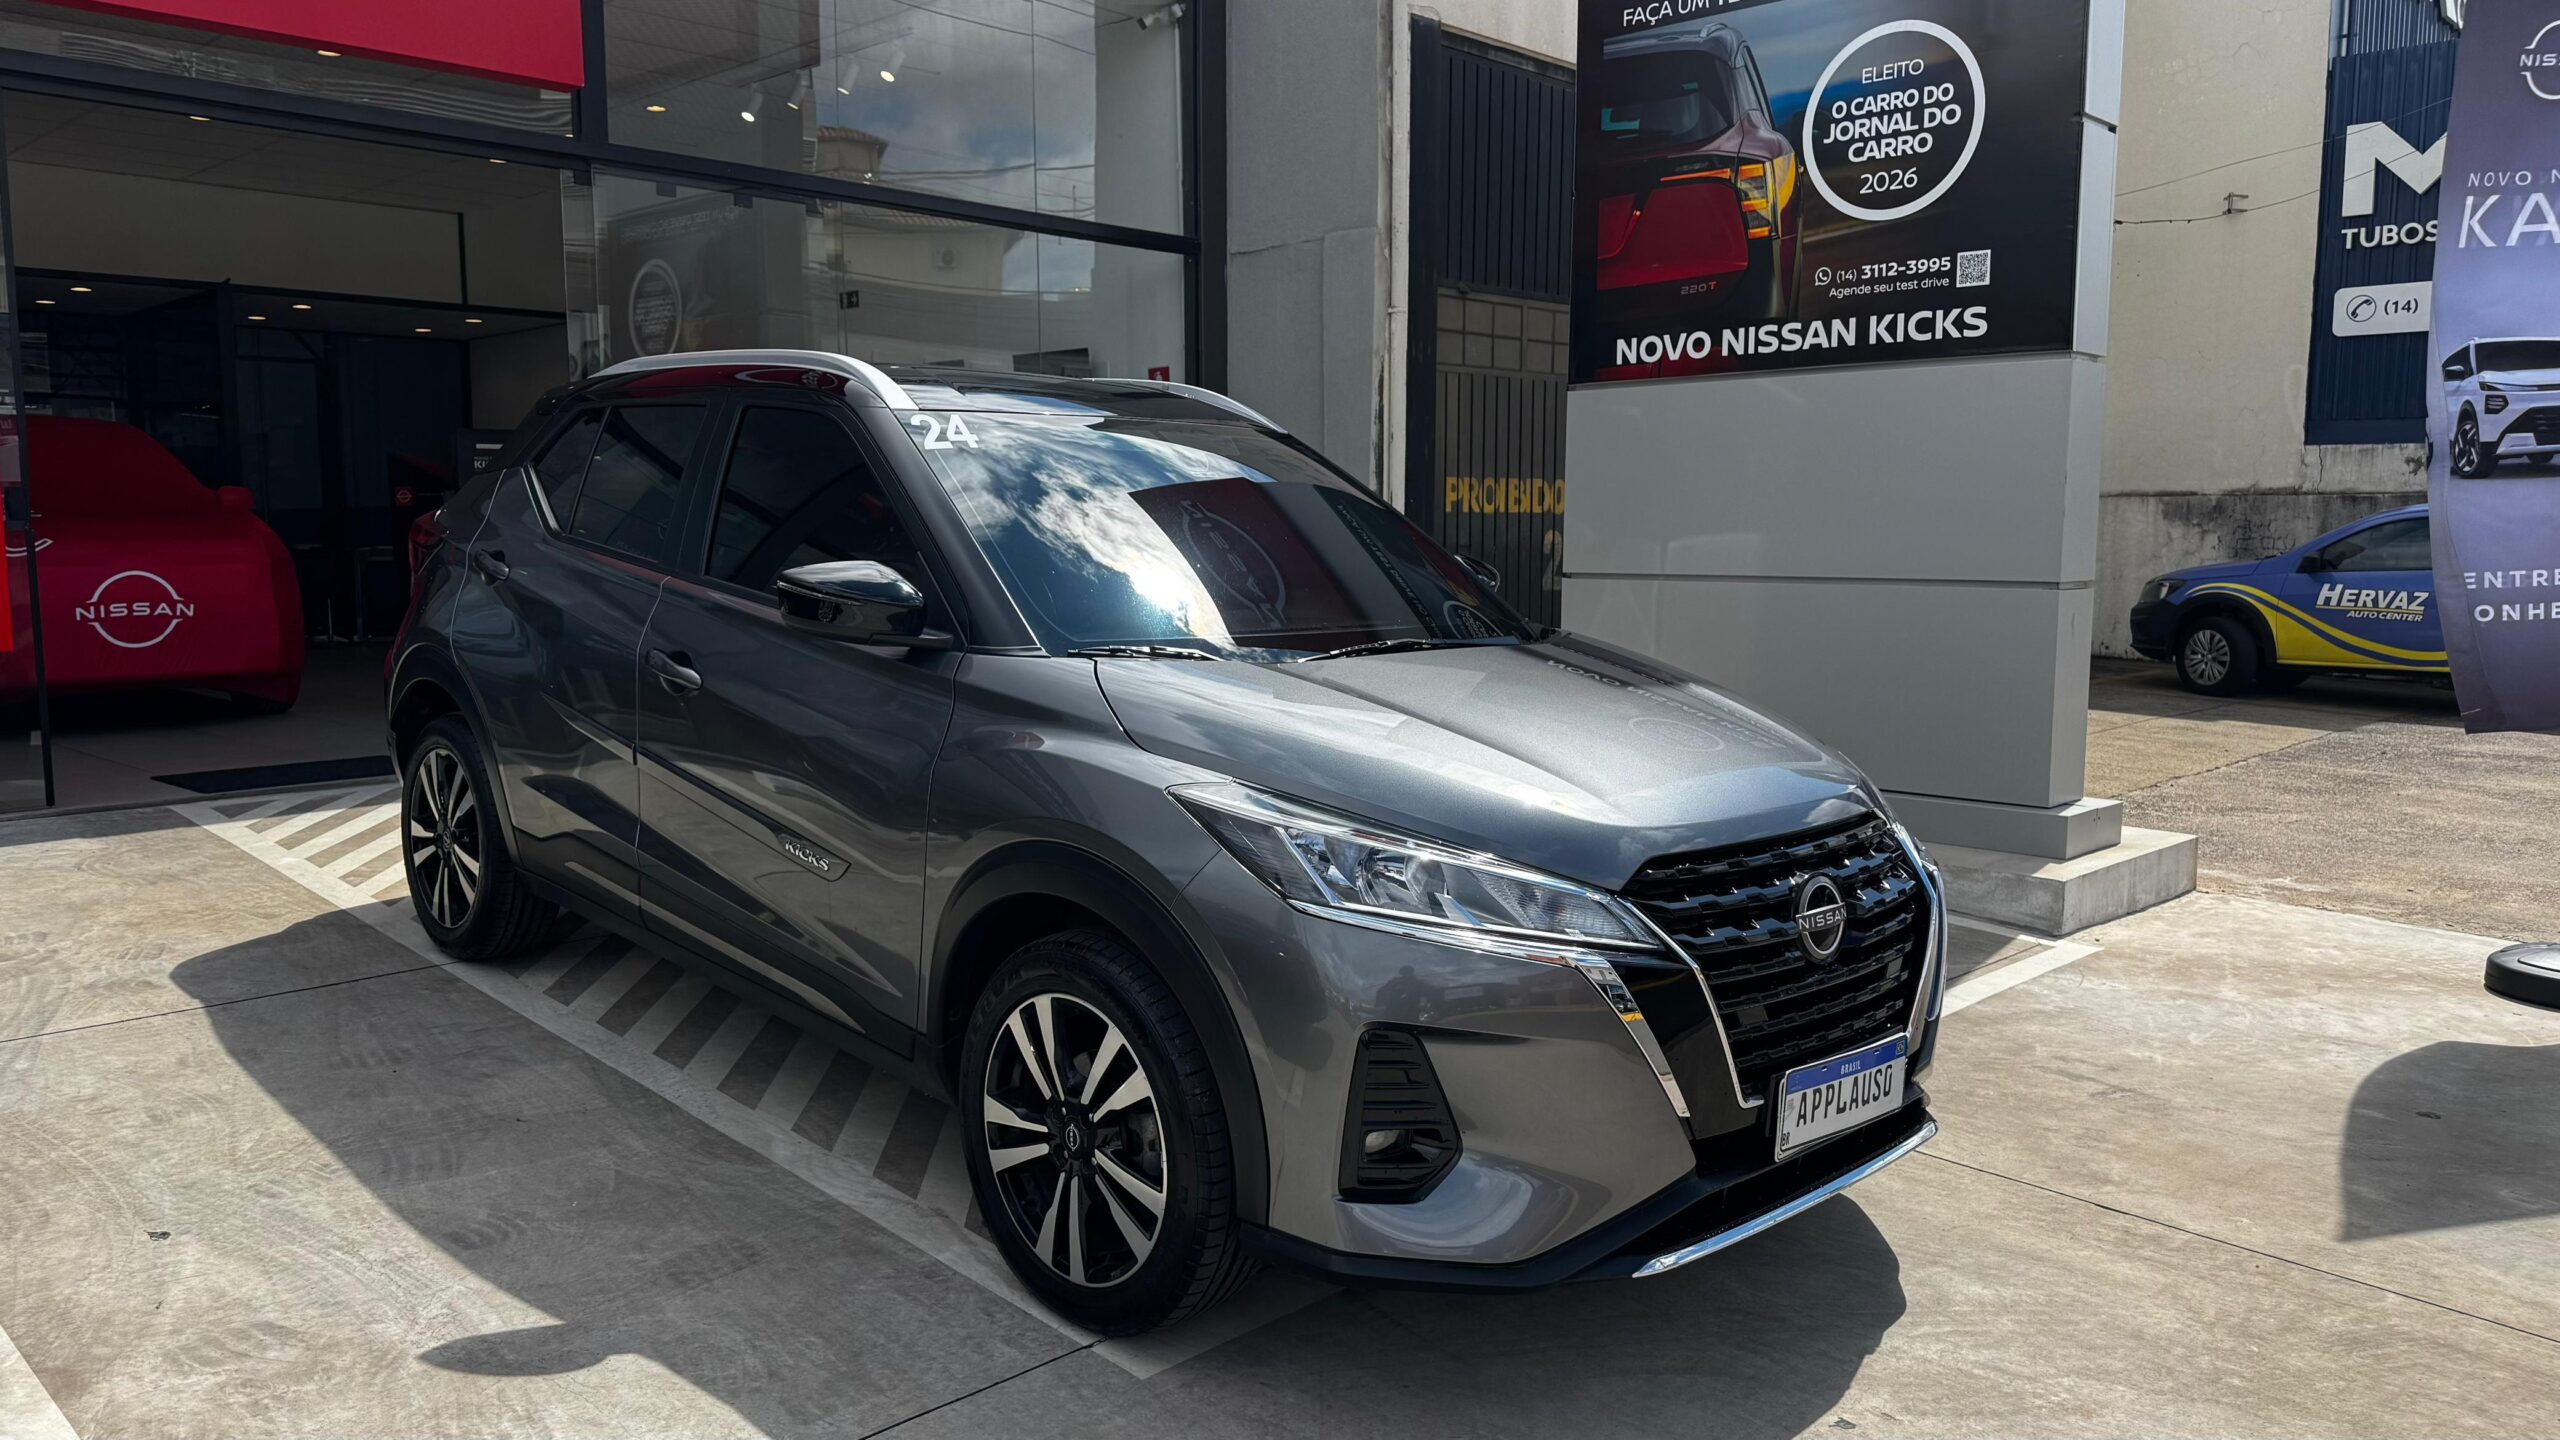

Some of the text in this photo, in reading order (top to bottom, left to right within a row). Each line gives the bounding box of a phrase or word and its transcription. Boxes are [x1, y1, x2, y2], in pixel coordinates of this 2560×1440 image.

[1622, 1, 1674, 27] FAÇA
[1862, 58, 1925, 84] ELEITO
[2520, 53, 2560, 67] NIS
[1831, 82, 1954, 119] O CARRO DO
[1823, 103, 1962, 144] JORNAL DO
[1848, 132, 1934, 163] CARRO
[1859, 167, 1918, 194] 2026
[2468, 171, 2532, 188] NOVO
[1836, 256, 1951, 284] (14) 3112-3995
[1829, 277, 1950, 299] Agende seu test drive
[2384, 298, 2419, 316] (14)
[1615, 305, 1989, 366] NOVO NISSAN KICKS
[910, 414, 980, 450] 24
[1445, 476, 1565, 515] PROIBIDO
[2316, 583, 2430, 611] HERVAZ
[75, 602, 194, 621] NISSAN
[2346, 610, 2423, 622] AUTO CENTER
[785, 840, 829, 871] KICKS
[1799, 905, 1847, 930] NISSAN
[1840, 1060, 1861, 1075] BRASIL
[1796, 1064, 1893, 1128] APPLAUSO
